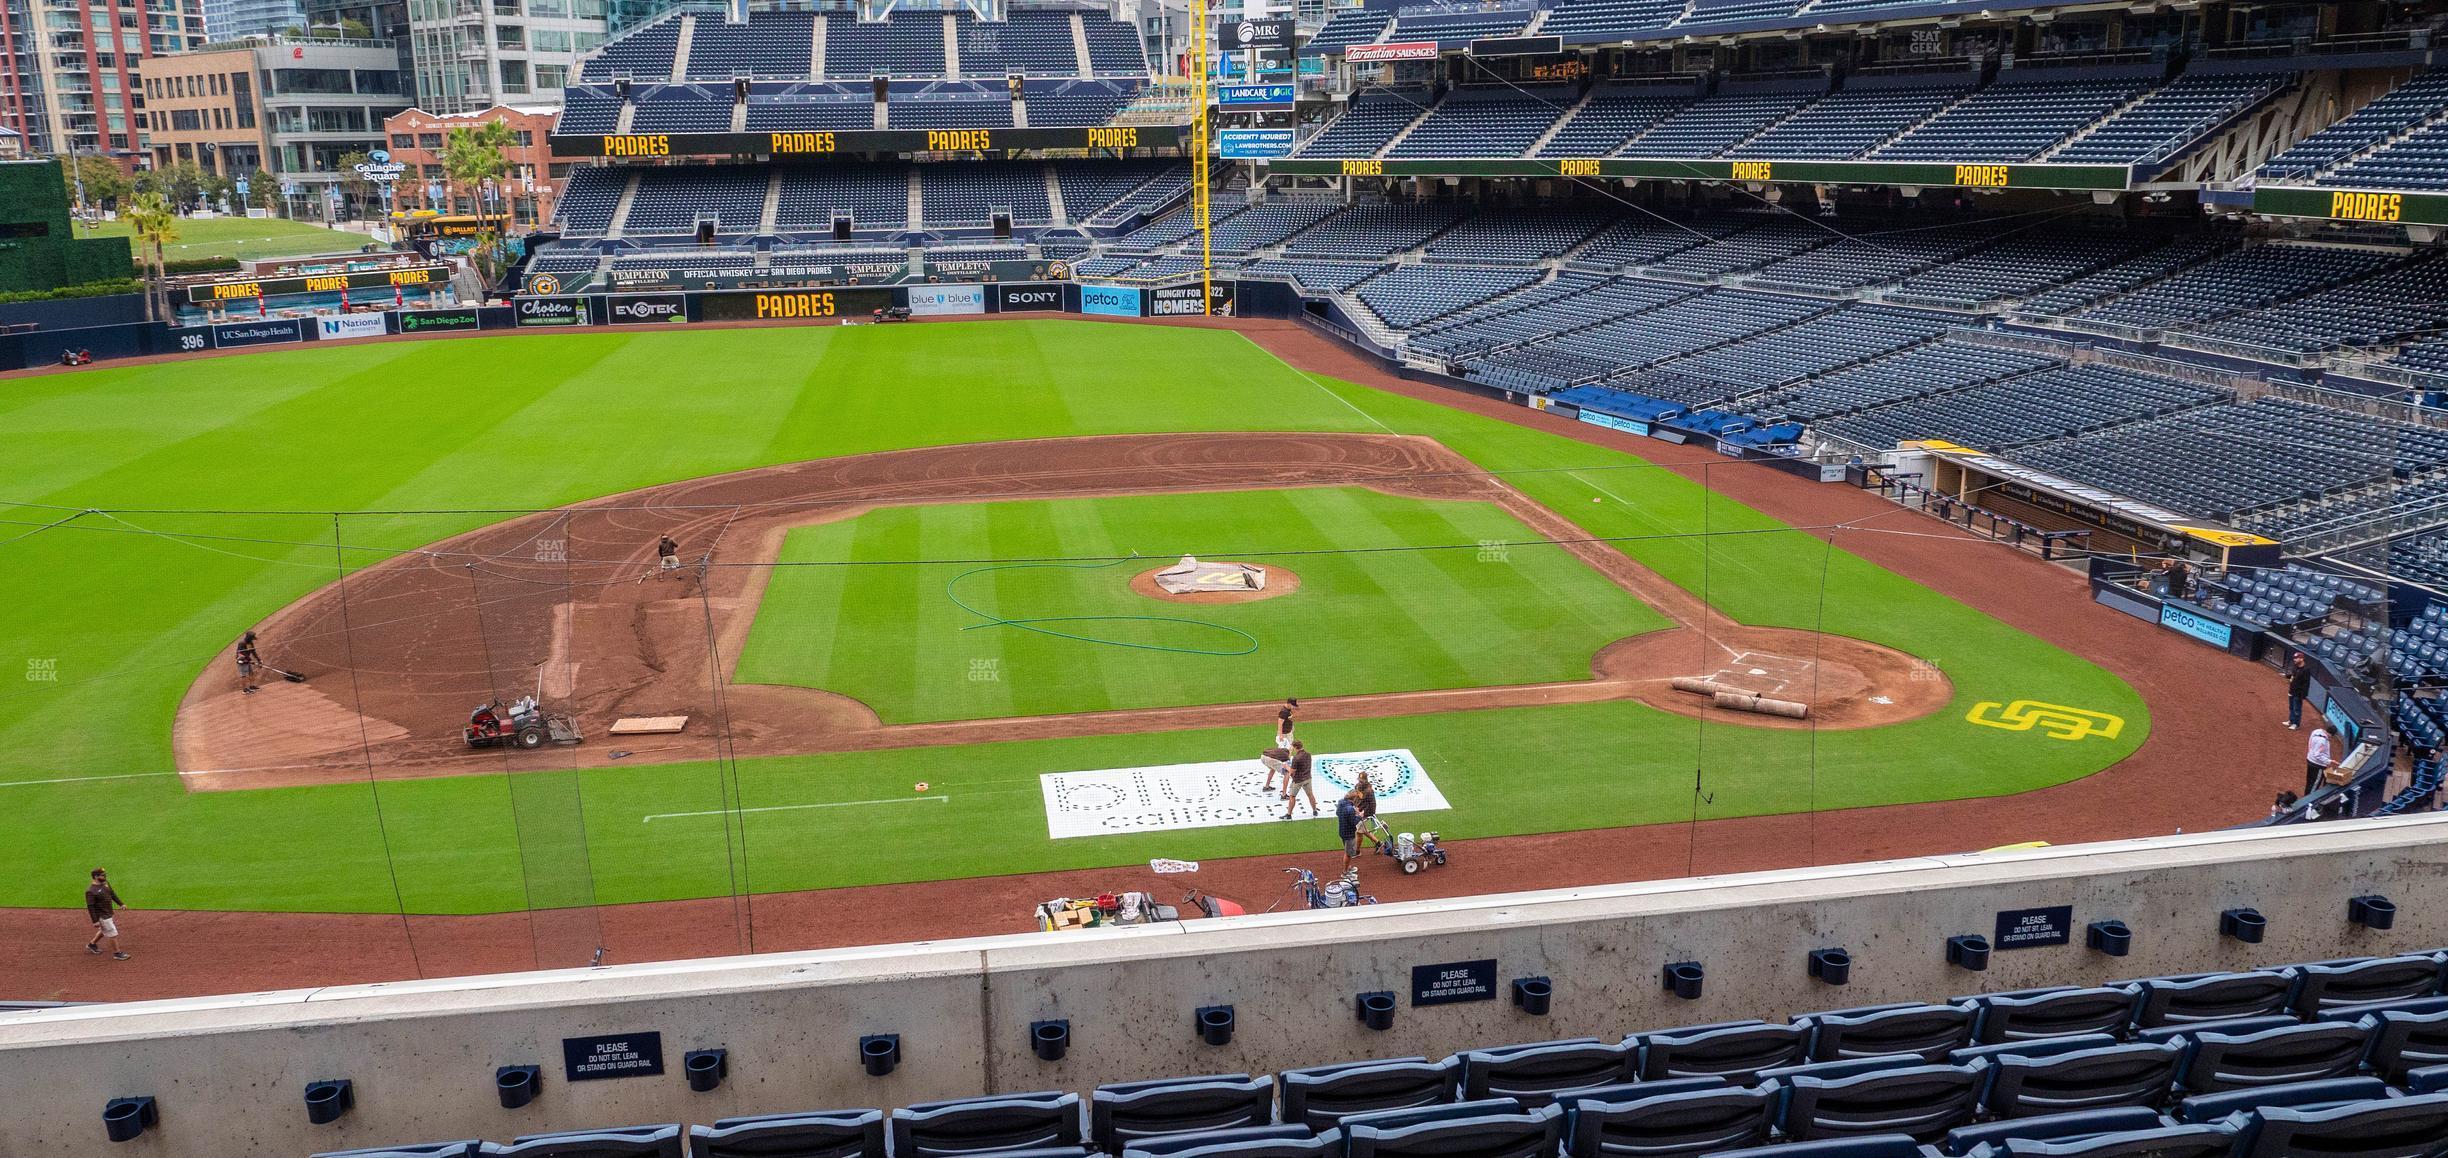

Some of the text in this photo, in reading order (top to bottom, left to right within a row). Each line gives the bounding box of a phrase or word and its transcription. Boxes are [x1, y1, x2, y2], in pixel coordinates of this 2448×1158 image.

[1254, 25, 1280, 36] MRC
[1347, 48, 1435, 59] Tarantino SAUSAGES
[1231, 88, 1293, 98] LANDCARE LOGIC
[771, 132, 835, 153] PADRES
[927, 130, 990, 150] PADRES
[1087, 128, 1137, 148] PADRES
[603, 135, 669, 156] PADRES
[354, 162, 406, 176] Gallagher
[1342, 160, 1382, 175] PADRES
[1561, 160, 1600, 176] PADRES
[1732, 161, 1771, 180] PADRES
[363, 172, 400, 182] Square
[1954, 165, 2008, 186] PADRES
[2331, 191, 2401, 221] PADRES
[684, 269, 718, 278] OFFICIAL
[719, 268, 753, 277] WHISKEY
[771, 268, 785, 276] SAN
[786, 267, 805, 275] DIEGO
[807, 266, 832, 275] PADRES
[845, 264, 901, 274] TEMPLETON
[936, 262, 991, 272] TEMPLETON
[389, 270, 430, 285] PADRES
[611, 270, 670, 280] TEMPLETON
[306, 276, 348, 291] PADRES
[214, 282, 260, 299] PADRES
[1156, 288, 1201, 298] HUNGRY FOR
[1210, 286, 1224, 298] 322
[911, 294, 935, 304] blue
[948, 293, 971, 303] blue
[1008, 292, 1057, 304] SONY
[1084, 292, 1119, 307] petco
[521, 300, 572, 314] Chosen
[615, 301, 678, 318] EVOTEK
[756, 292, 835, 318] PADRES
[1153, 299, 1205, 314] HOMERS
[342, 317, 381, 328] National
[436, 316, 459, 326] Diego
[222, 326, 294, 339] UC San Diego Health
[181, 335, 205, 349] 396
[2163, 608, 2195, 628] petco
[2328, 699, 2344, 723] petco
[2021, 915, 2047, 925] PLEASE
[1440, 969, 1469, 980] PLEASE
[1432, 981, 1441, 989] DO
[1441, 980, 1452, 988] NOT
[1462, 978, 1477, 986] LEAN
[1421, 990, 1430, 998] OR
[1430, 989, 1448, 997] STAND
[1456, 987, 1475, 995] GUARD
[596, 1042, 629, 1054] PLEASE
[588, 1055, 598, 1063] DO
[598, 1054, 611, 1062] NOT
[622, 1052, 638, 1060] LEAN
[577, 1064, 586, 1072] OR
[586, 1063, 606, 1071] STAND
[607, 1062, 617, 1070] ON
[617, 1061, 638, 1069] GUARD
